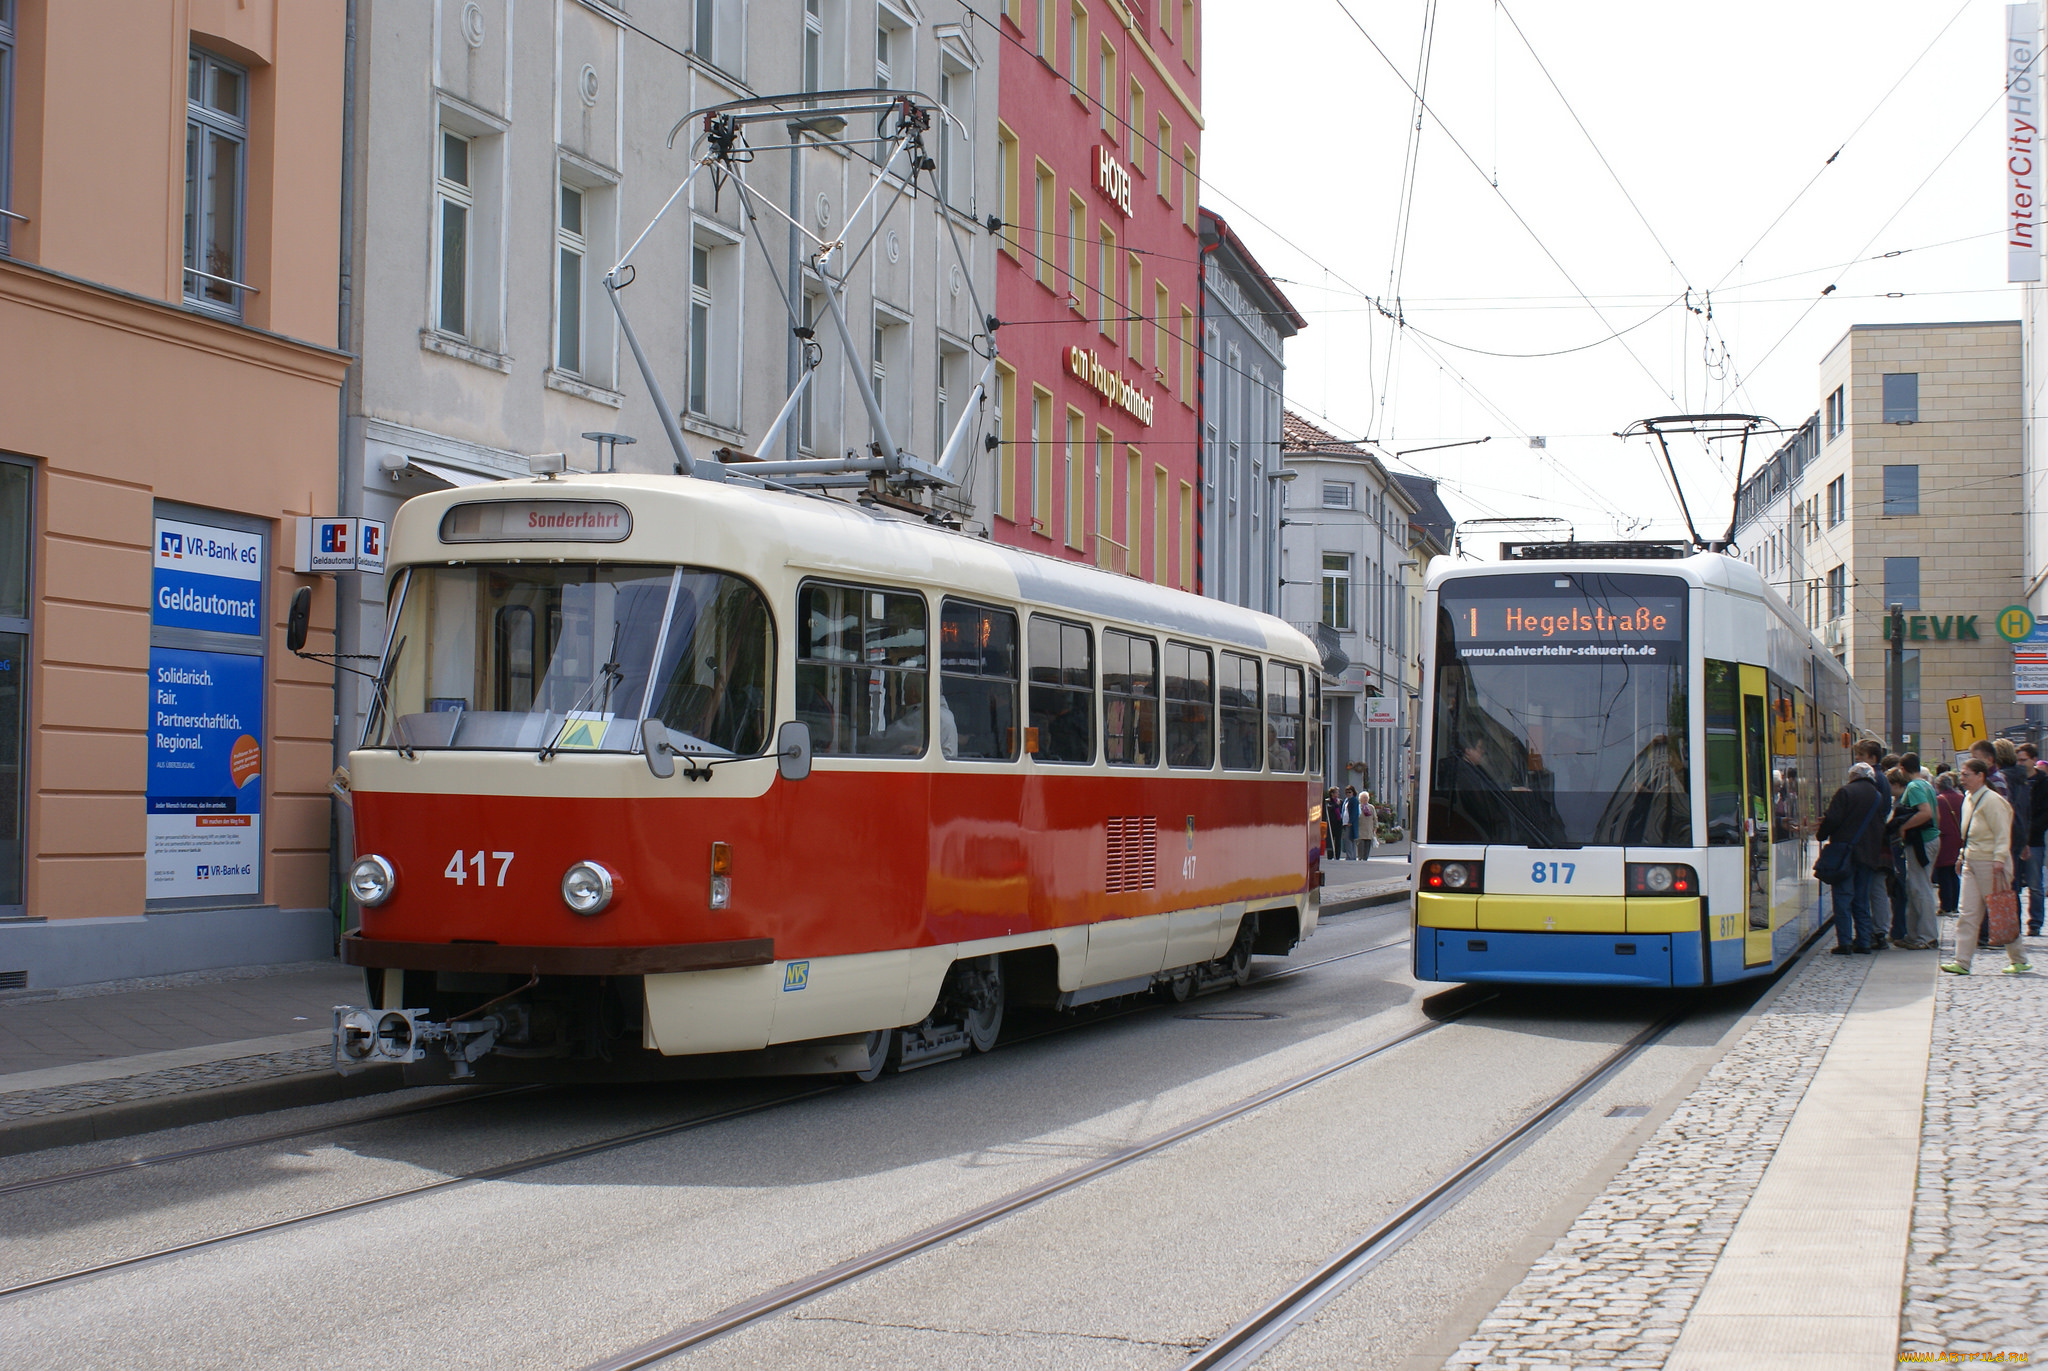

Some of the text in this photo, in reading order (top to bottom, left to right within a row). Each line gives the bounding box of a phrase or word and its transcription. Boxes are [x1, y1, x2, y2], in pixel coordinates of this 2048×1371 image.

[2008, 38, 2037, 248] InterCityHotel
[1100, 145, 1133, 219] HOTEL
[1071, 345, 1154, 428] am Hauptbahnhof
[528, 511, 619, 528] Sonderfahrt
[187, 536, 257, 564] VR-Bank eG
[312, 556, 355, 565] Geldautomat
[158, 586, 256, 618] Geldautomat
[1506, 607, 1666, 637] Hegelstraße
[1460, 644, 1657, 657] www.nahverkehr-schwerin.de
[157, 667, 213, 686] Solidarisch.
[157, 689, 178, 705] Fair.
[157, 711, 242, 729] Partnerschaftlich.
[1951, 705, 1960, 713] U
[156, 733, 203, 753] Regional.
[211, 864, 251, 876] VR-Bank eG
[444, 849, 515, 887] 417
[1182, 856, 1197, 880] 417
[1531, 862, 1576, 885] 817
[1720, 915, 1735, 938] 817
